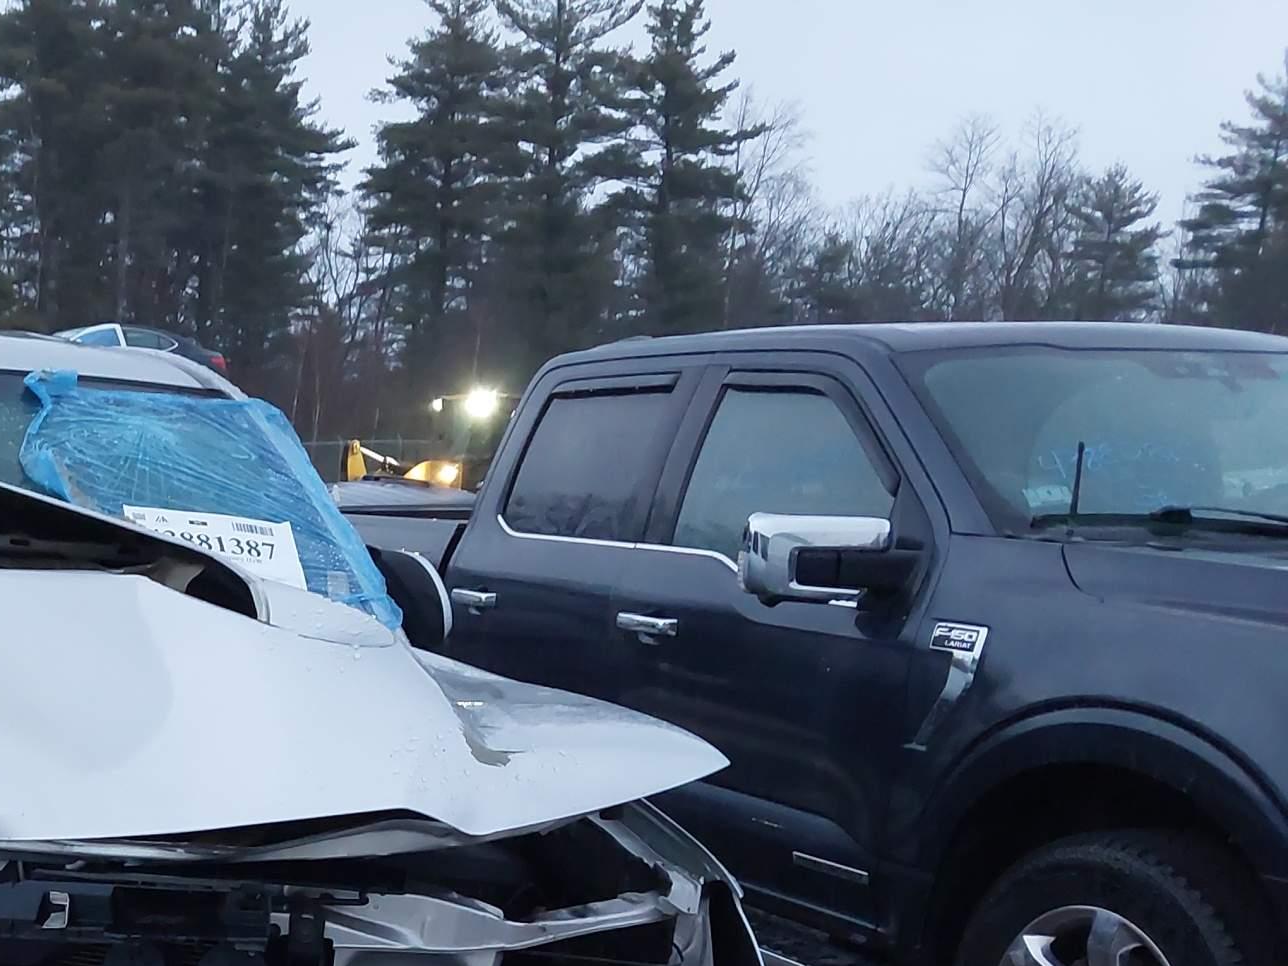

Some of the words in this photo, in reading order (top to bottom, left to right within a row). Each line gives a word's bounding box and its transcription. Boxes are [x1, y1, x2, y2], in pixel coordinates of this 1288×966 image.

[154, 528, 274, 560] 881387
[934, 627, 978, 642] F-150
[944, 640, 972, 649] LARIAT
